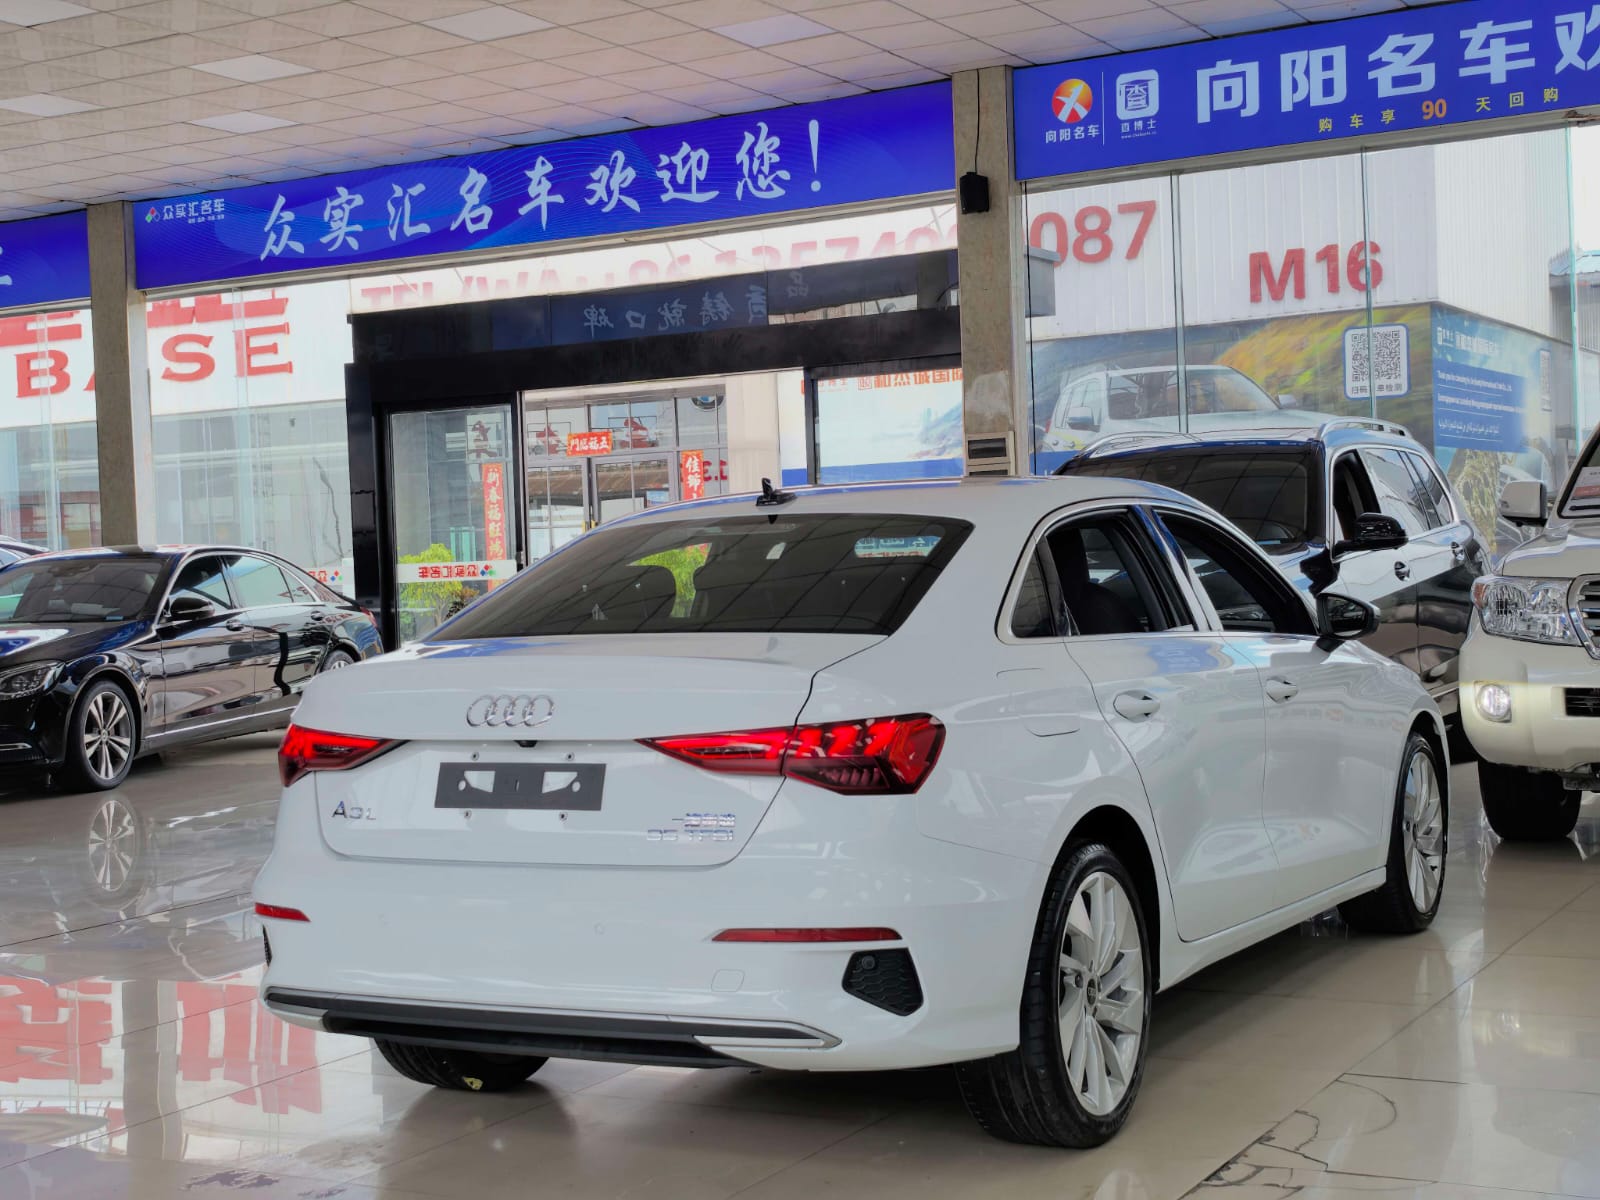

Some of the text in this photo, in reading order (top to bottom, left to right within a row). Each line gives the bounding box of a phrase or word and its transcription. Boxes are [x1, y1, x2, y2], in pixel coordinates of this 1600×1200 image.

[1045, 124, 1100, 144] 向阳名车
[162, 198, 225, 220] 众实汇名车
[1019, 199, 1157, 268] 087
[1249, 240, 1384, 304] M16
[15, 322, 293, 398] BSE
